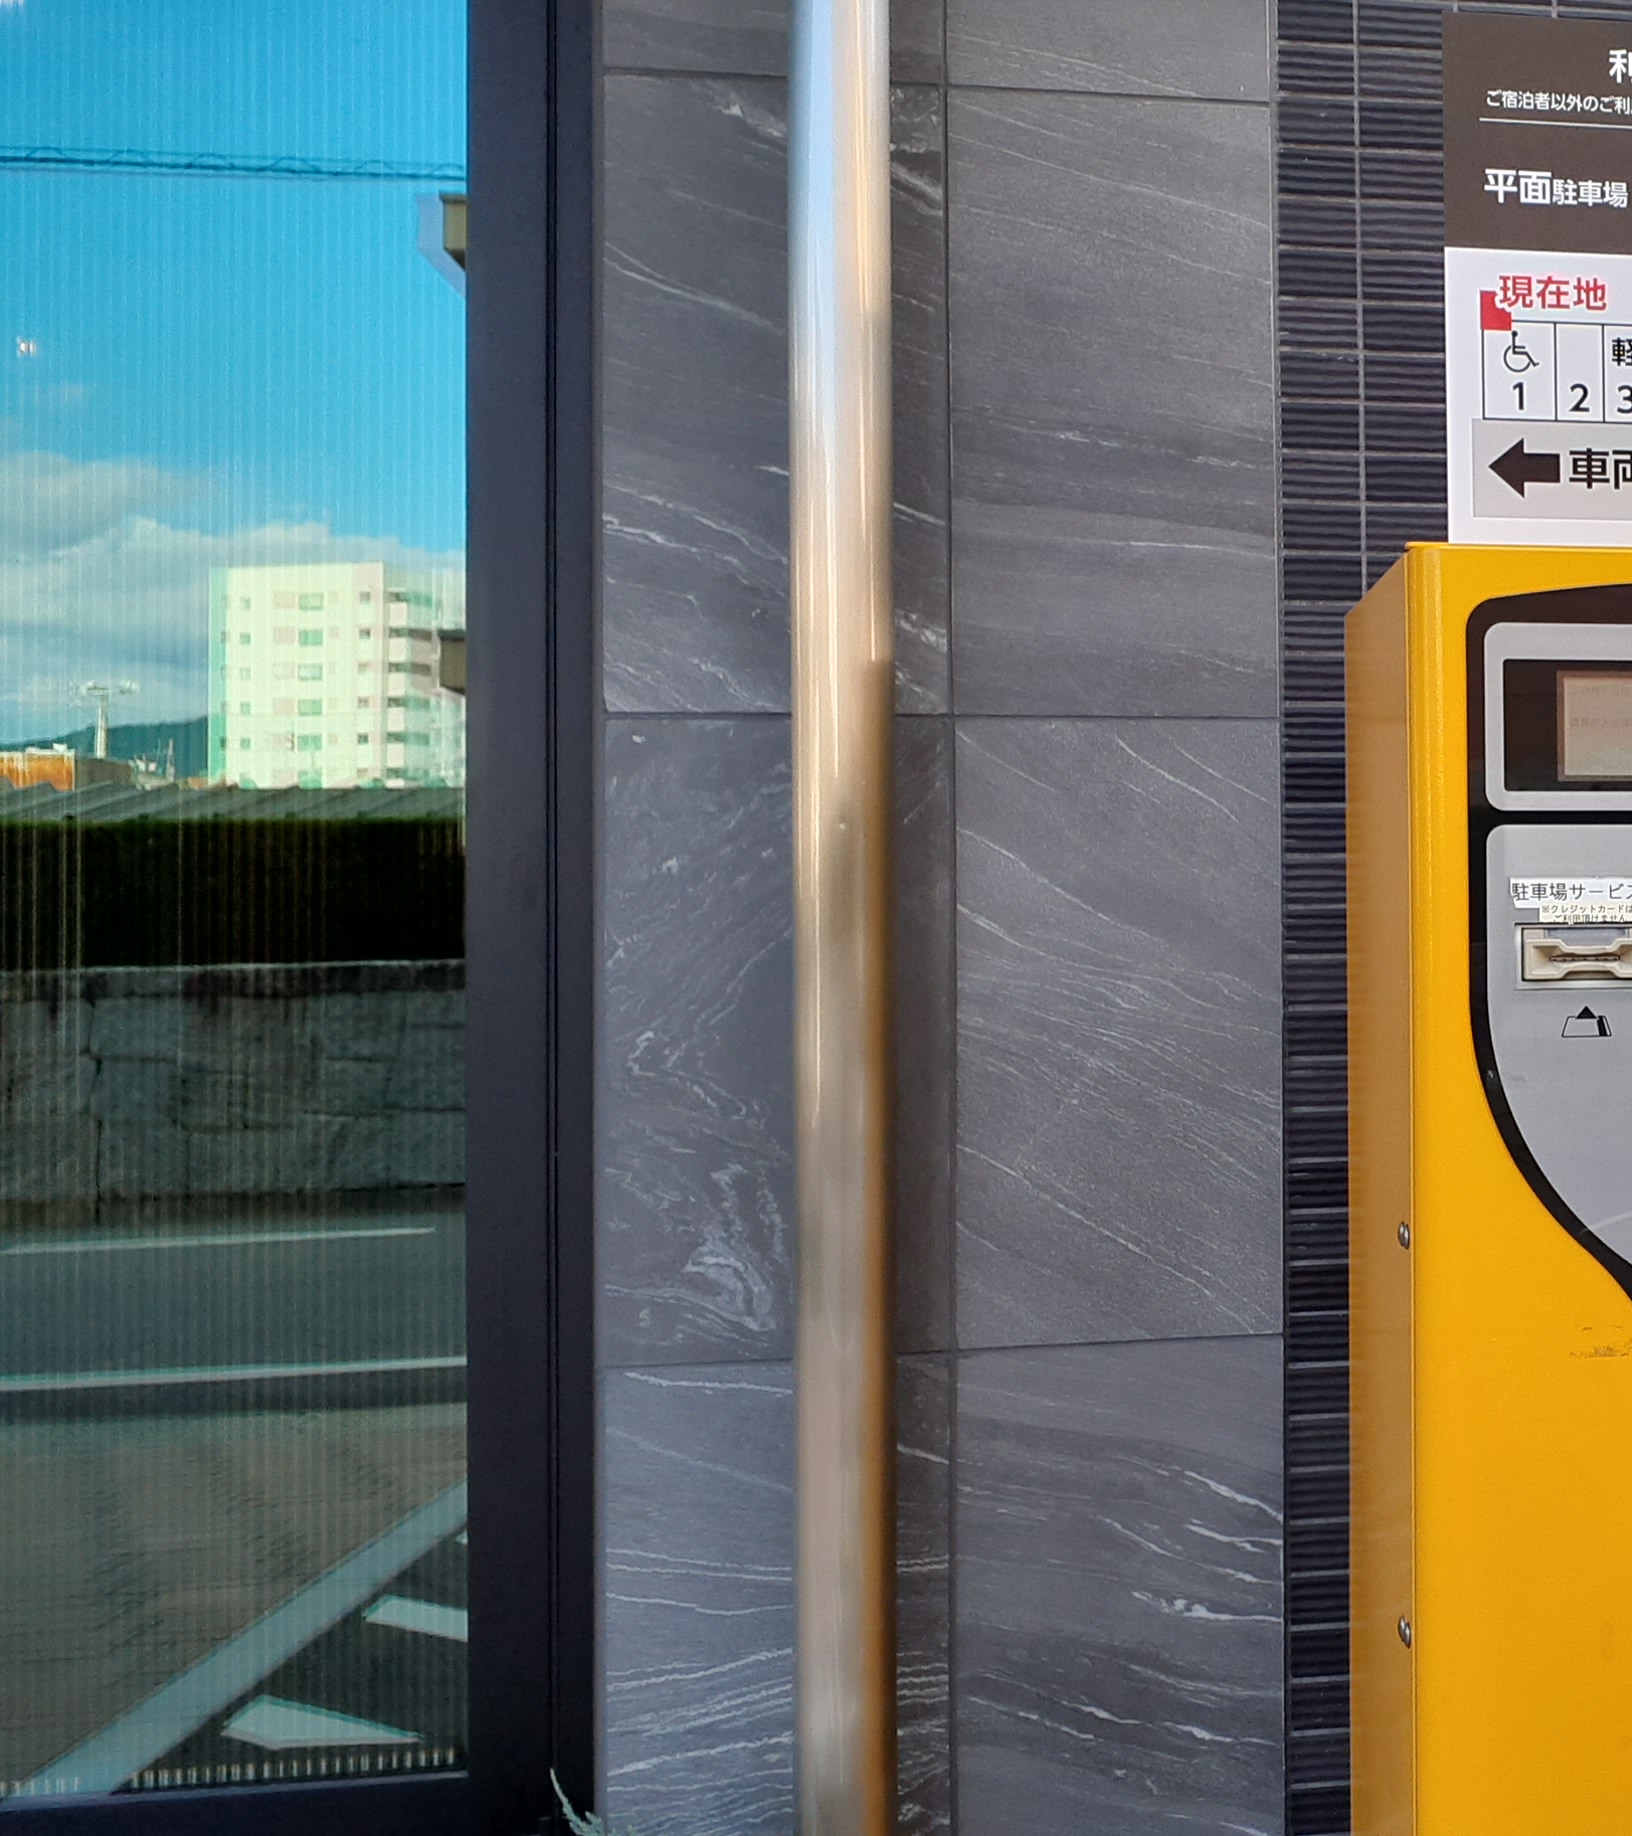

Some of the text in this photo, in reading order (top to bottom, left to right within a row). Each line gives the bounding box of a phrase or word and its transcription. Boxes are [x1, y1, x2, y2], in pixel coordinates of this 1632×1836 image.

[1484, 168, 1629, 208] 平面駐車場
[1499, 275, 1607, 311] 現在地
[1511, 382, 1525, 411] 1
[1569, 383, 1591, 412] 2
